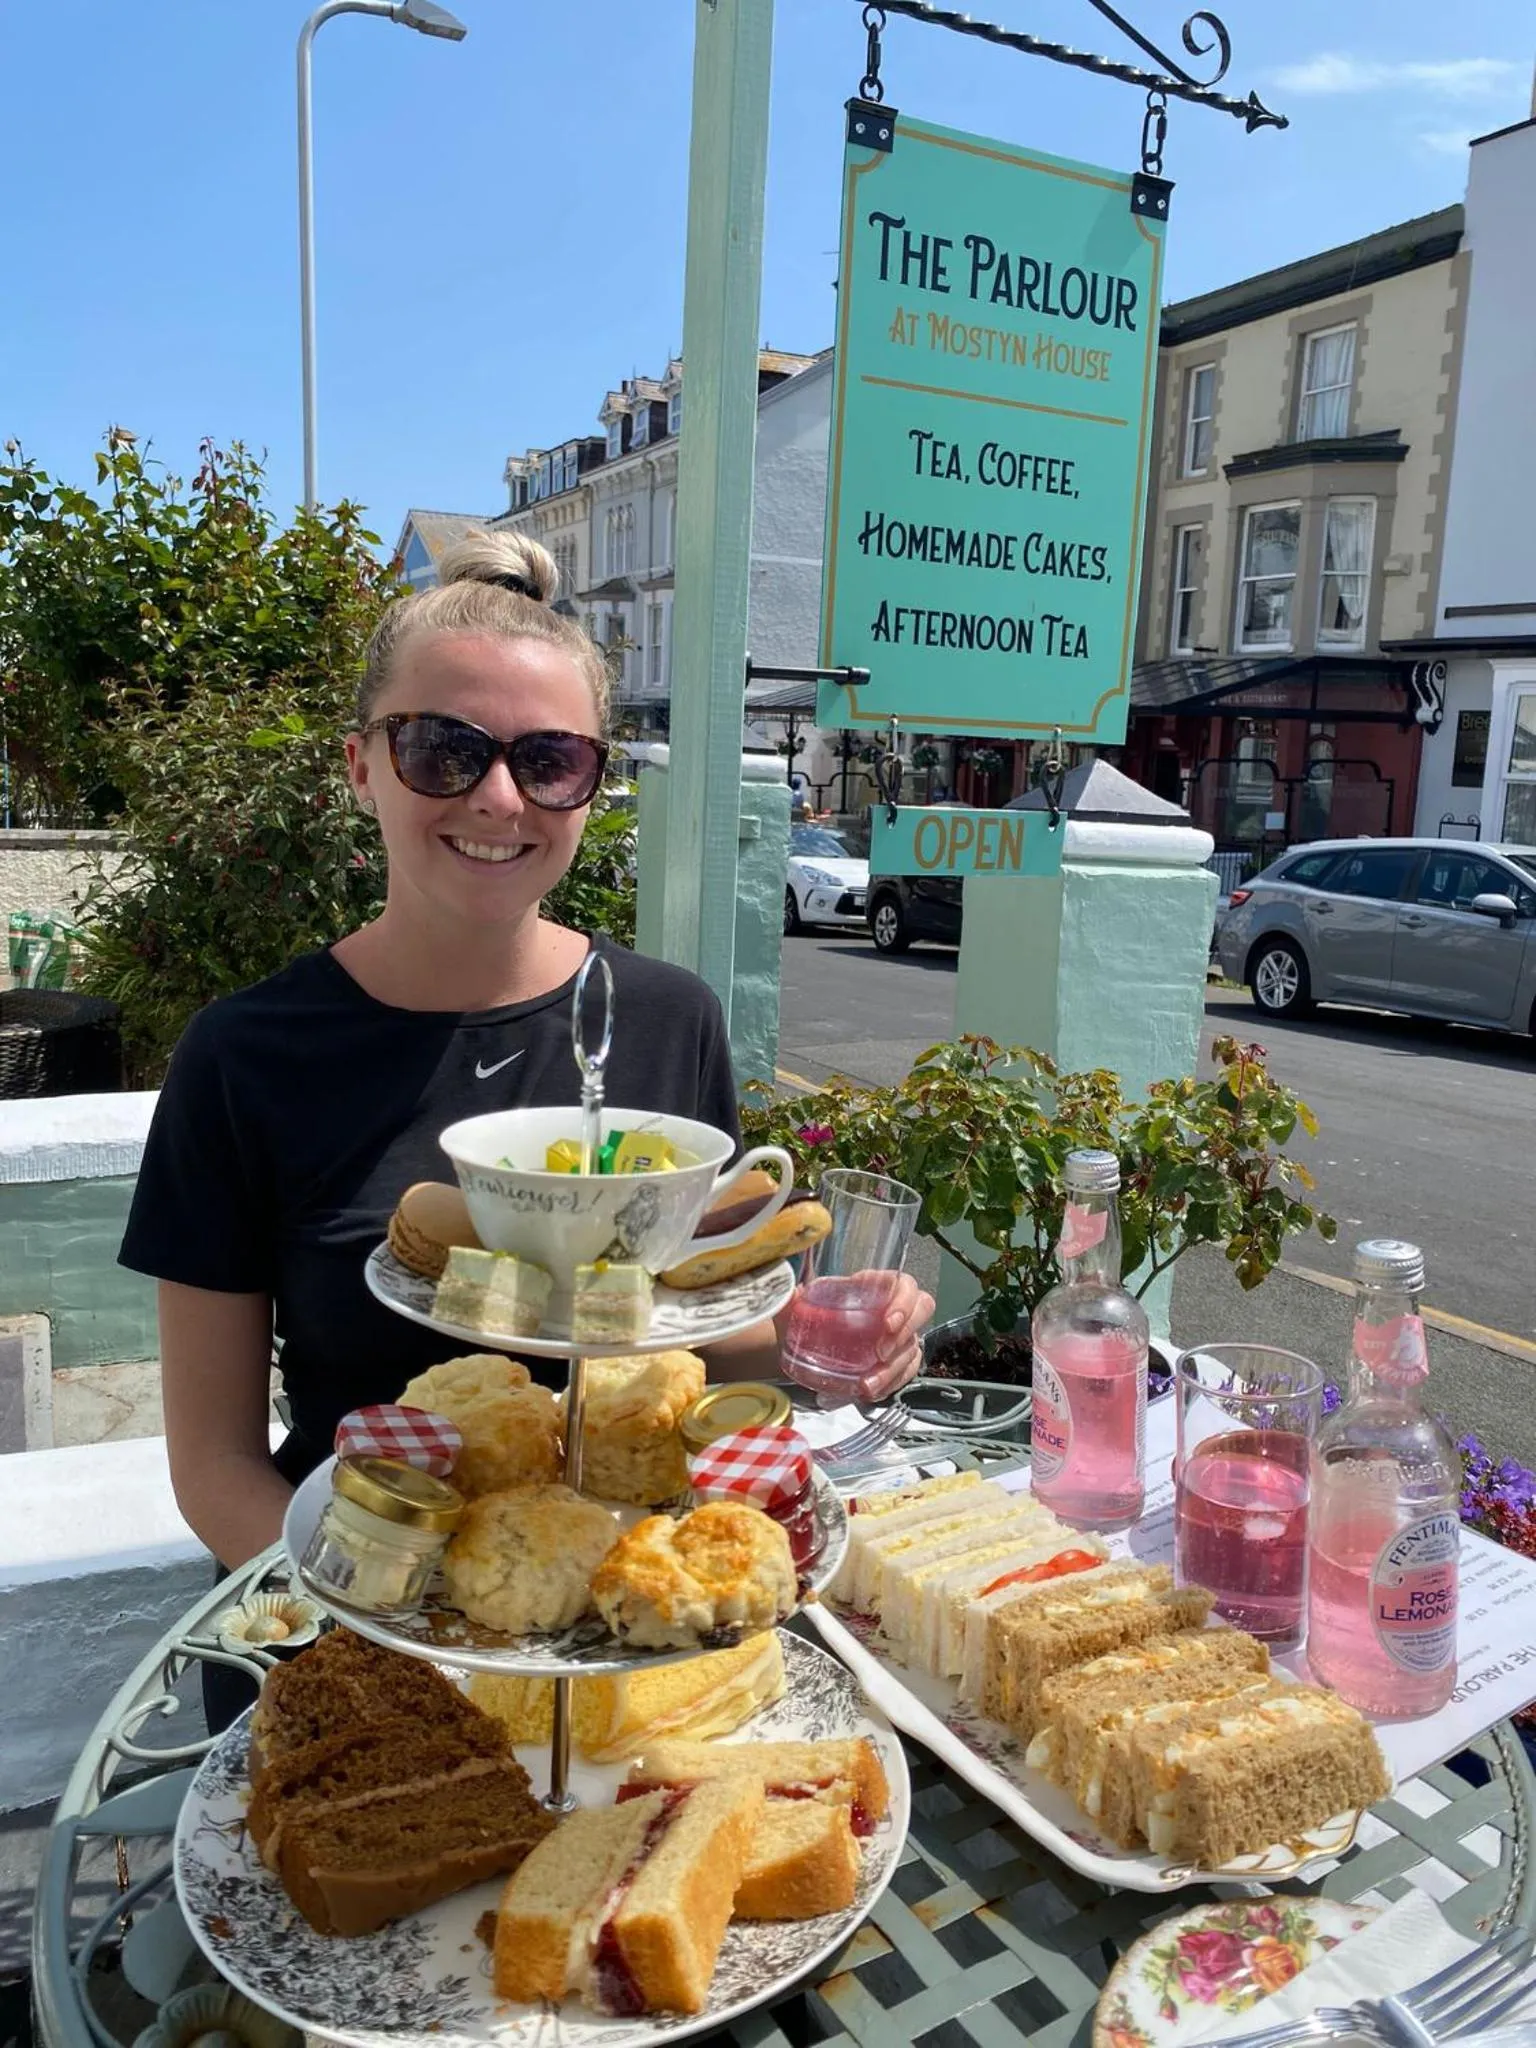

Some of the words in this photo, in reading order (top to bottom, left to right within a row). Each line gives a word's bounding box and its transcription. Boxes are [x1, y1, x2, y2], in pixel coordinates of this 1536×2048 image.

[868, 211, 953, 293] THE
[964, 234, 1138, 332] PARLOUR
[889, 306, 920, 346] AT
[927, 312, 1028, 367] MOSTYN
[1032, 333, 1112, 382] HOUSE
[909, 429, 970, 484] TEA,
[978, 442, 1080, 499] COFFEE,
[858, 511, 1017, 571] HOMEMADE
[1023, 532, 1112, 583] CAKES,
[871, 600, 1033, 654] AFTERNOON
[1041, 615, 1088, 659] TEA
[914, 815, 1025, 871] OPEN
